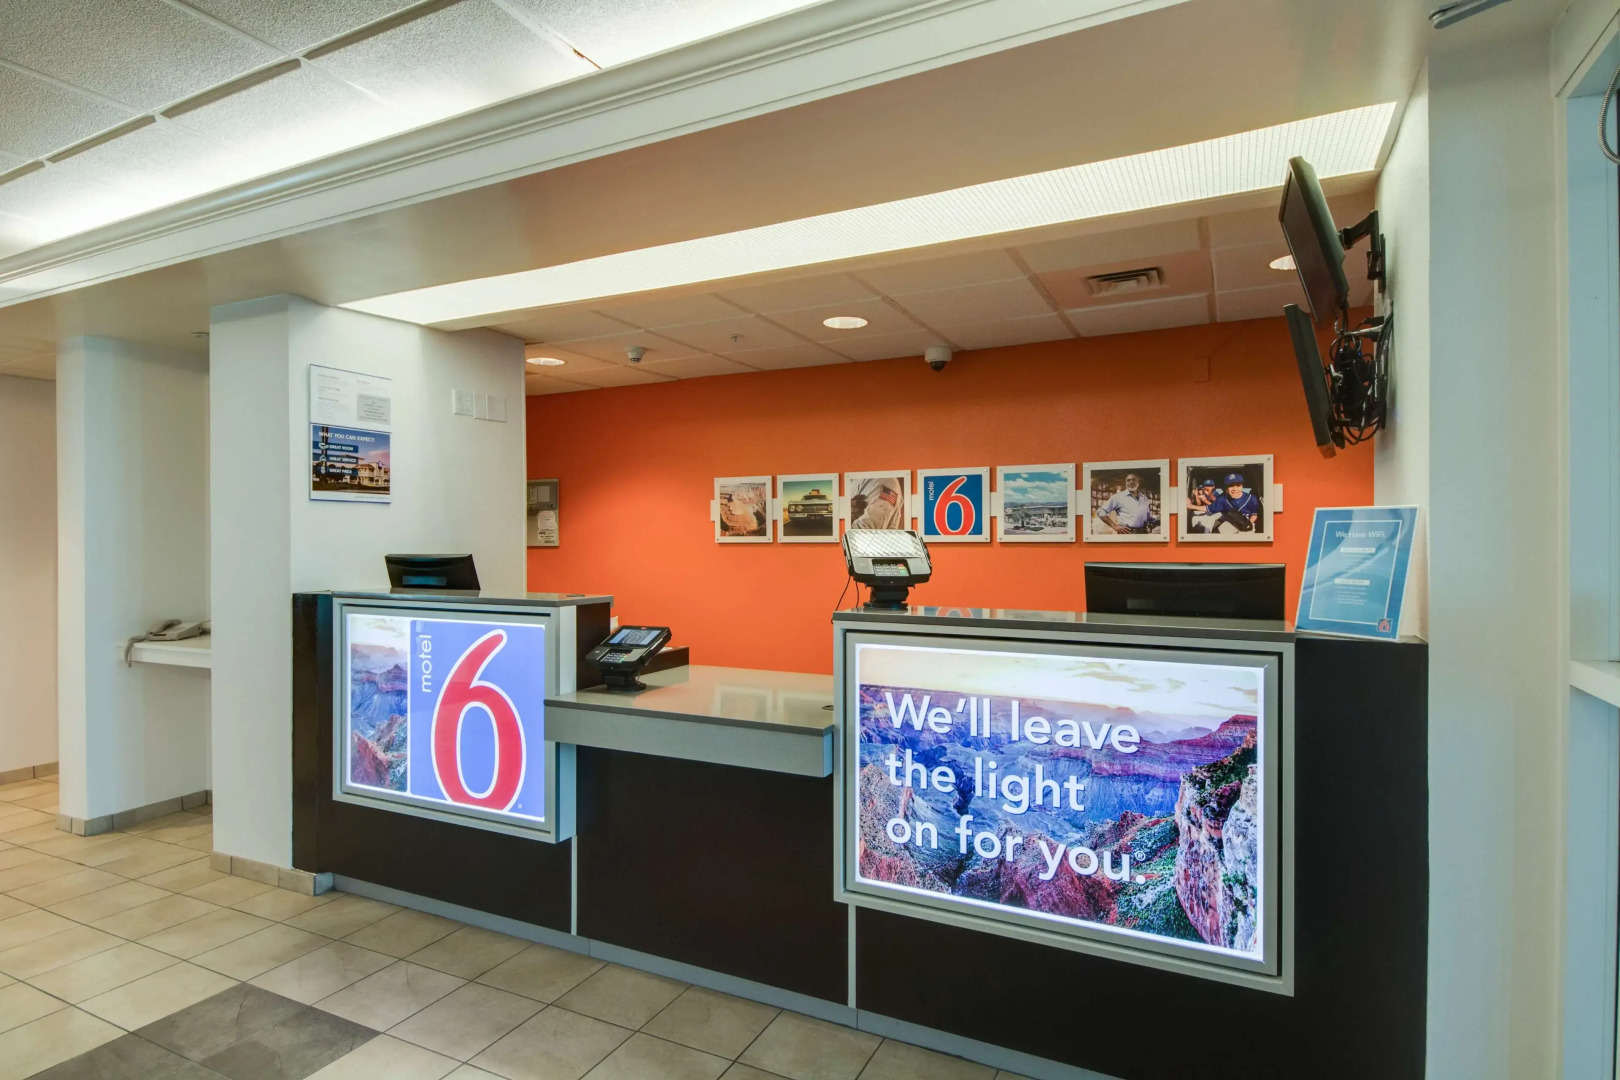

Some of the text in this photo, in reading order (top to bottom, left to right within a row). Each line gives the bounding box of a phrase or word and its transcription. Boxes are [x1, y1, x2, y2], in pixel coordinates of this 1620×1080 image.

[933, 475, 976, 536] 6
[1335, 530, 1347, 538] We
[420, 628, 527, 813] motel 6
[885, 691, 1141, 755] We'll leave
[885, 749, 1086, 815] the light
[886, 816, 939, 850] on
[954, 814, 1024, 862] for
